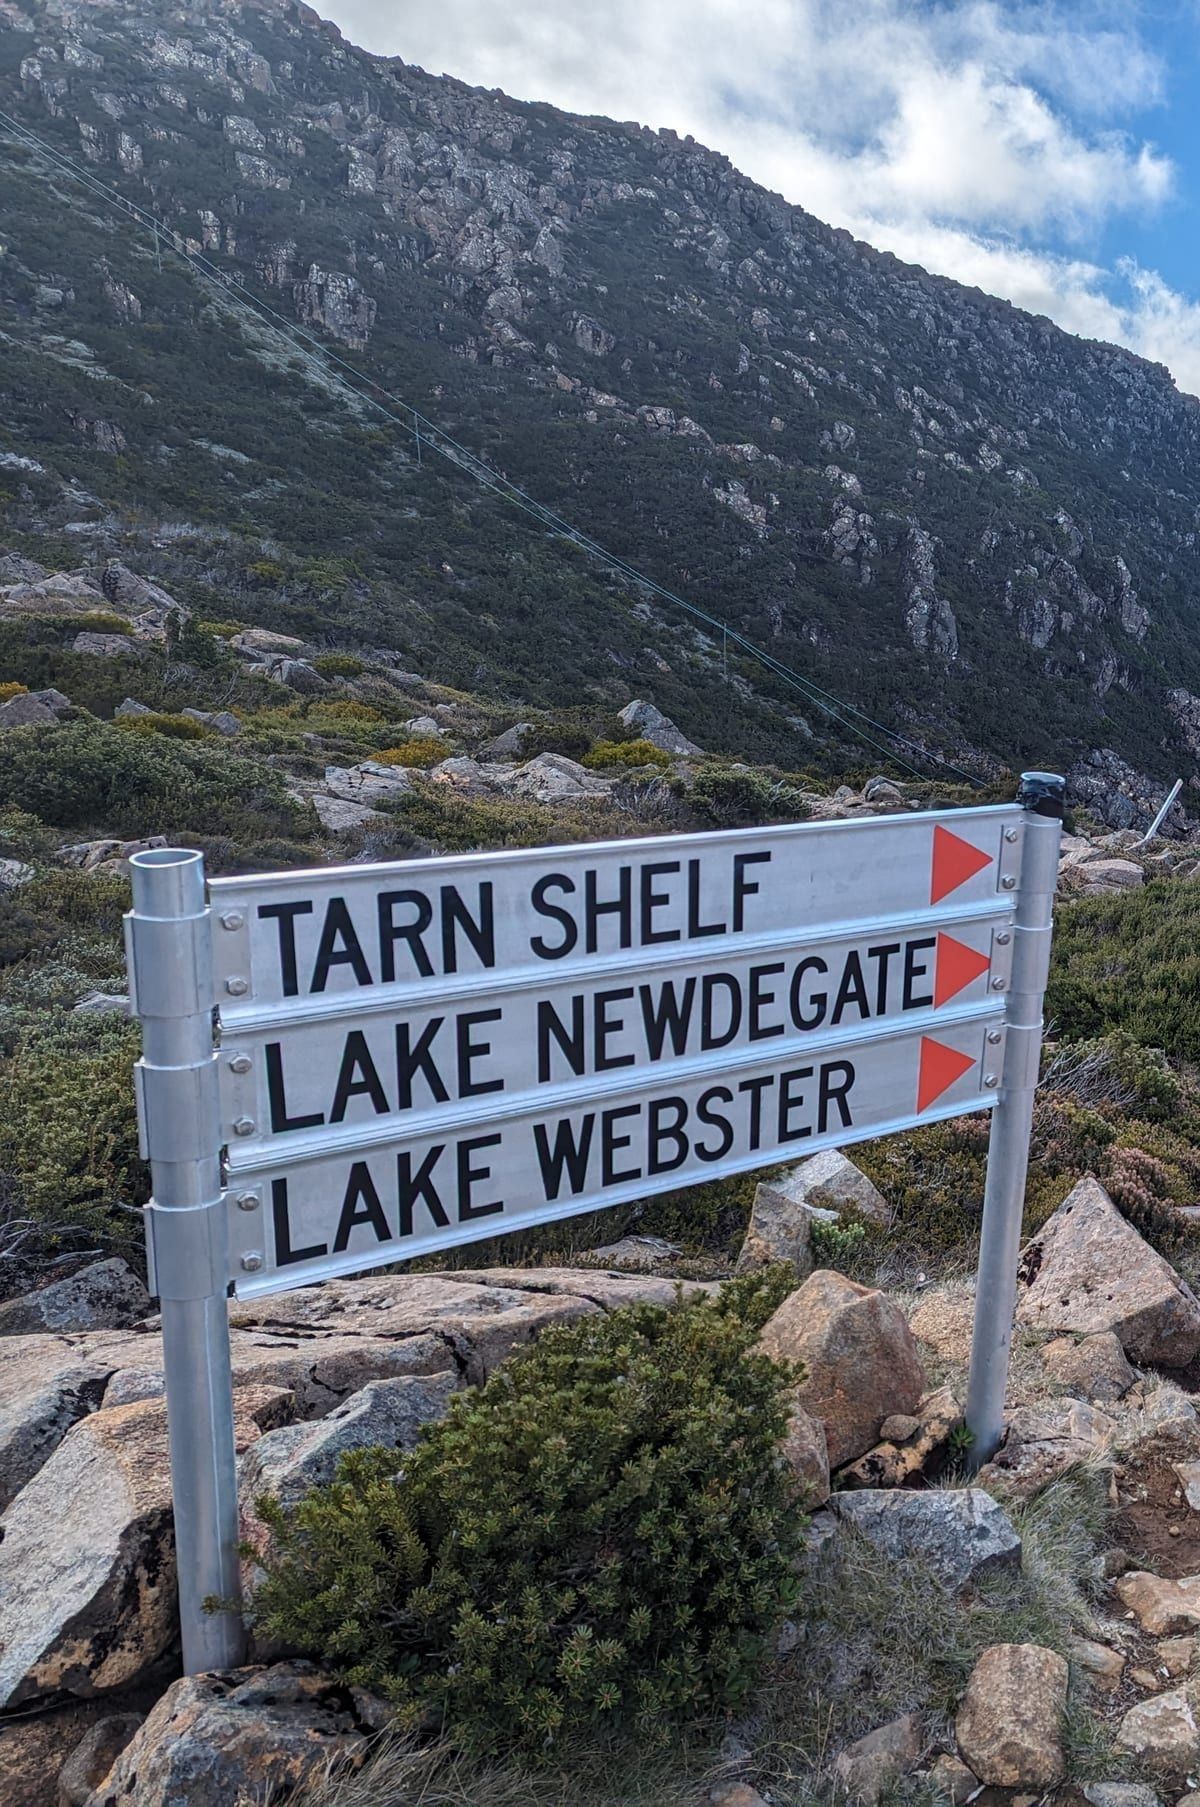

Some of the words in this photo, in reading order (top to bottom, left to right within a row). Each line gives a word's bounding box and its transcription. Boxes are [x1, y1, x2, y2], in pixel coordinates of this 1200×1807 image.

[258, 881, 496, 997] TARN
[530, 850, 772, 960] SHELF
[265, 1008, 505, 1134] LAKE
[537, 936, 937, 1083] NEWDEGATE
[271, 1133, 505, 1267] LAKE
[533, 1060, 855, 1201] WEBSTER
